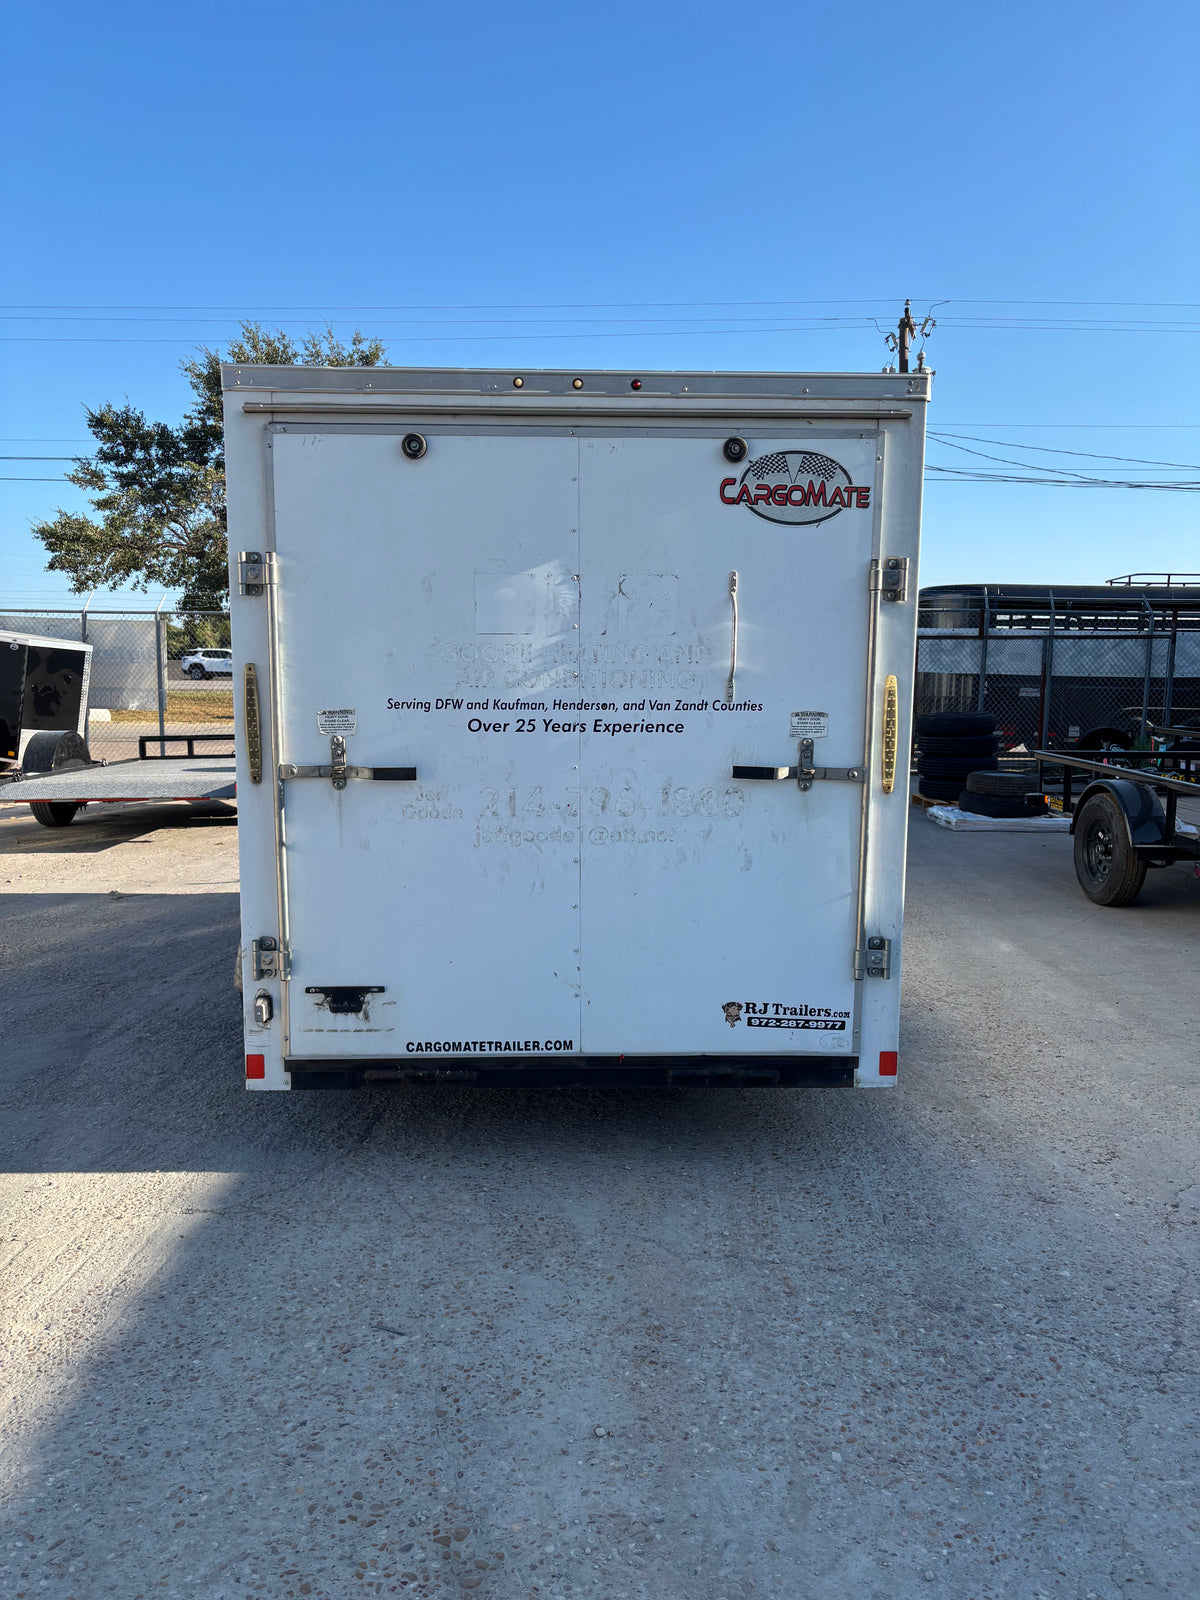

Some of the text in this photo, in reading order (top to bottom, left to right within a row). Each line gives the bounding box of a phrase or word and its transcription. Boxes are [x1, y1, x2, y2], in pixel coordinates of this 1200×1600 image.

[387, 698, 763, 712] Serving DFW and Kaufman, Henderson, and Van Zandt Counties
[467, 718, 685, 736] Over 25 Years Experience
[744, 1002, 769, 1015] RJ
[751, 1018, 842, 1029] 972-287-9977
[406, 1040, 573, 1053] CARGOMATETRAILER.COM
